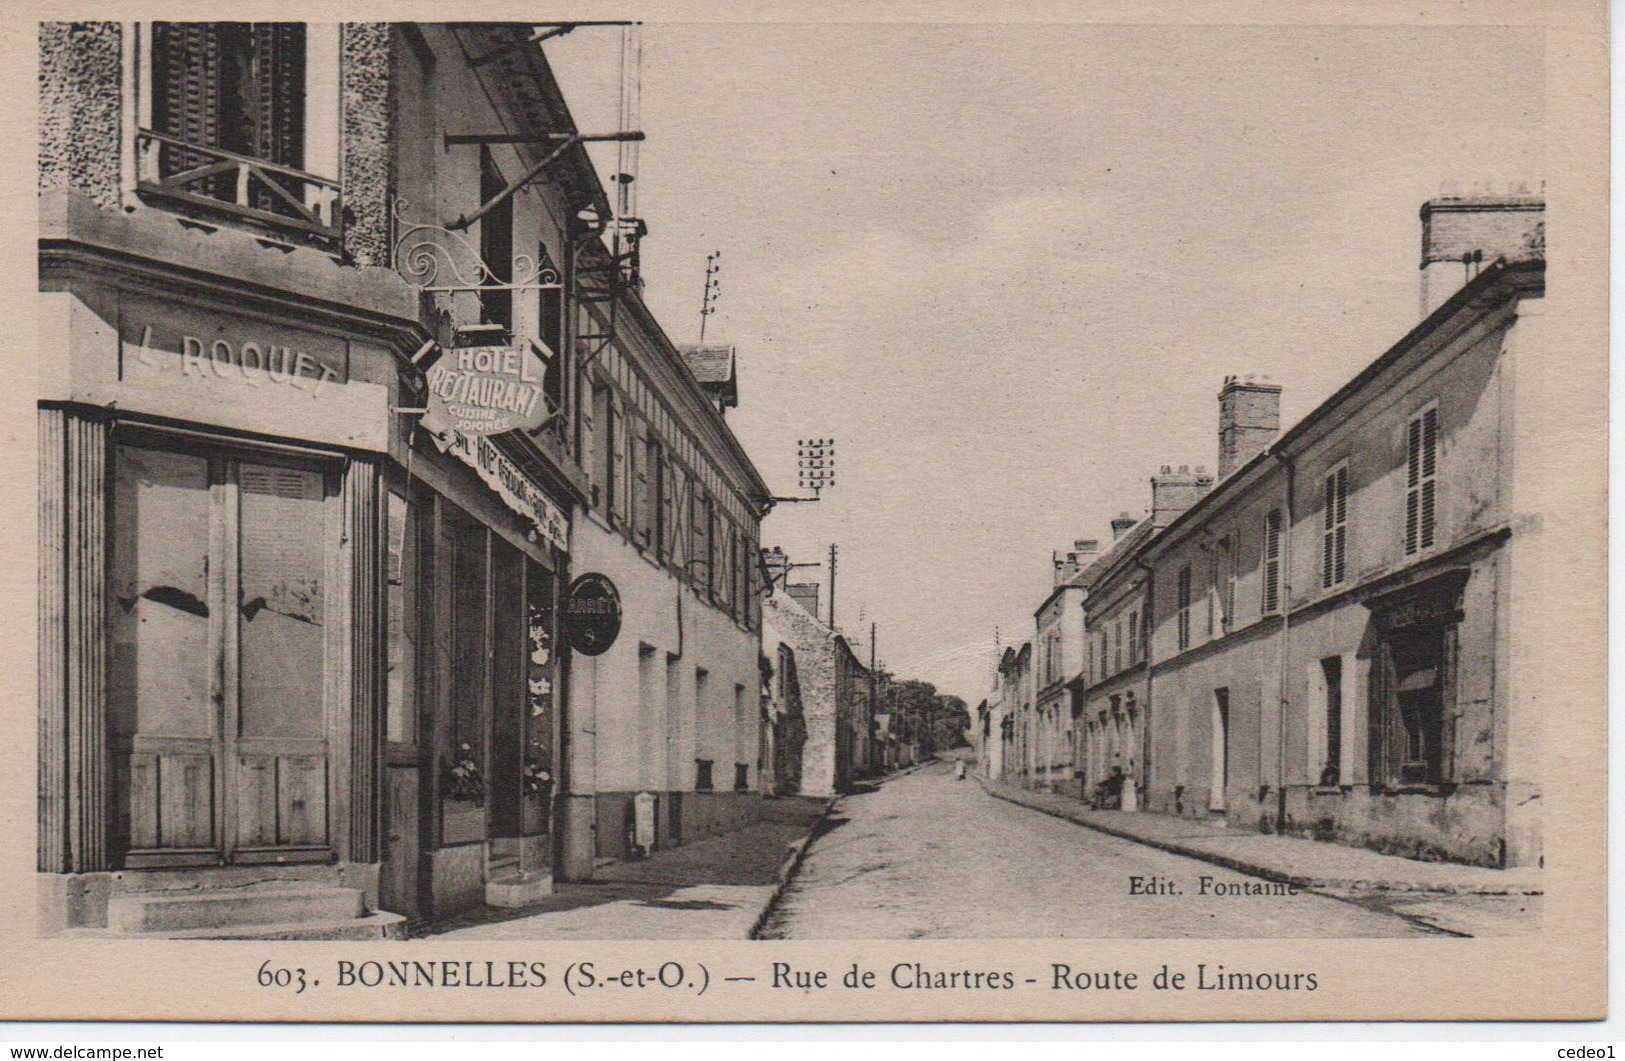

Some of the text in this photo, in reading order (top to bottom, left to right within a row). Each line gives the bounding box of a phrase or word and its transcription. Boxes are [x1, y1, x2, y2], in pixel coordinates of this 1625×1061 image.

[181, 335, 339, 400] ROQUET
[429, 365, 544, 418] RESTAURANT
[447, 404, 498, 420] CUISINE
